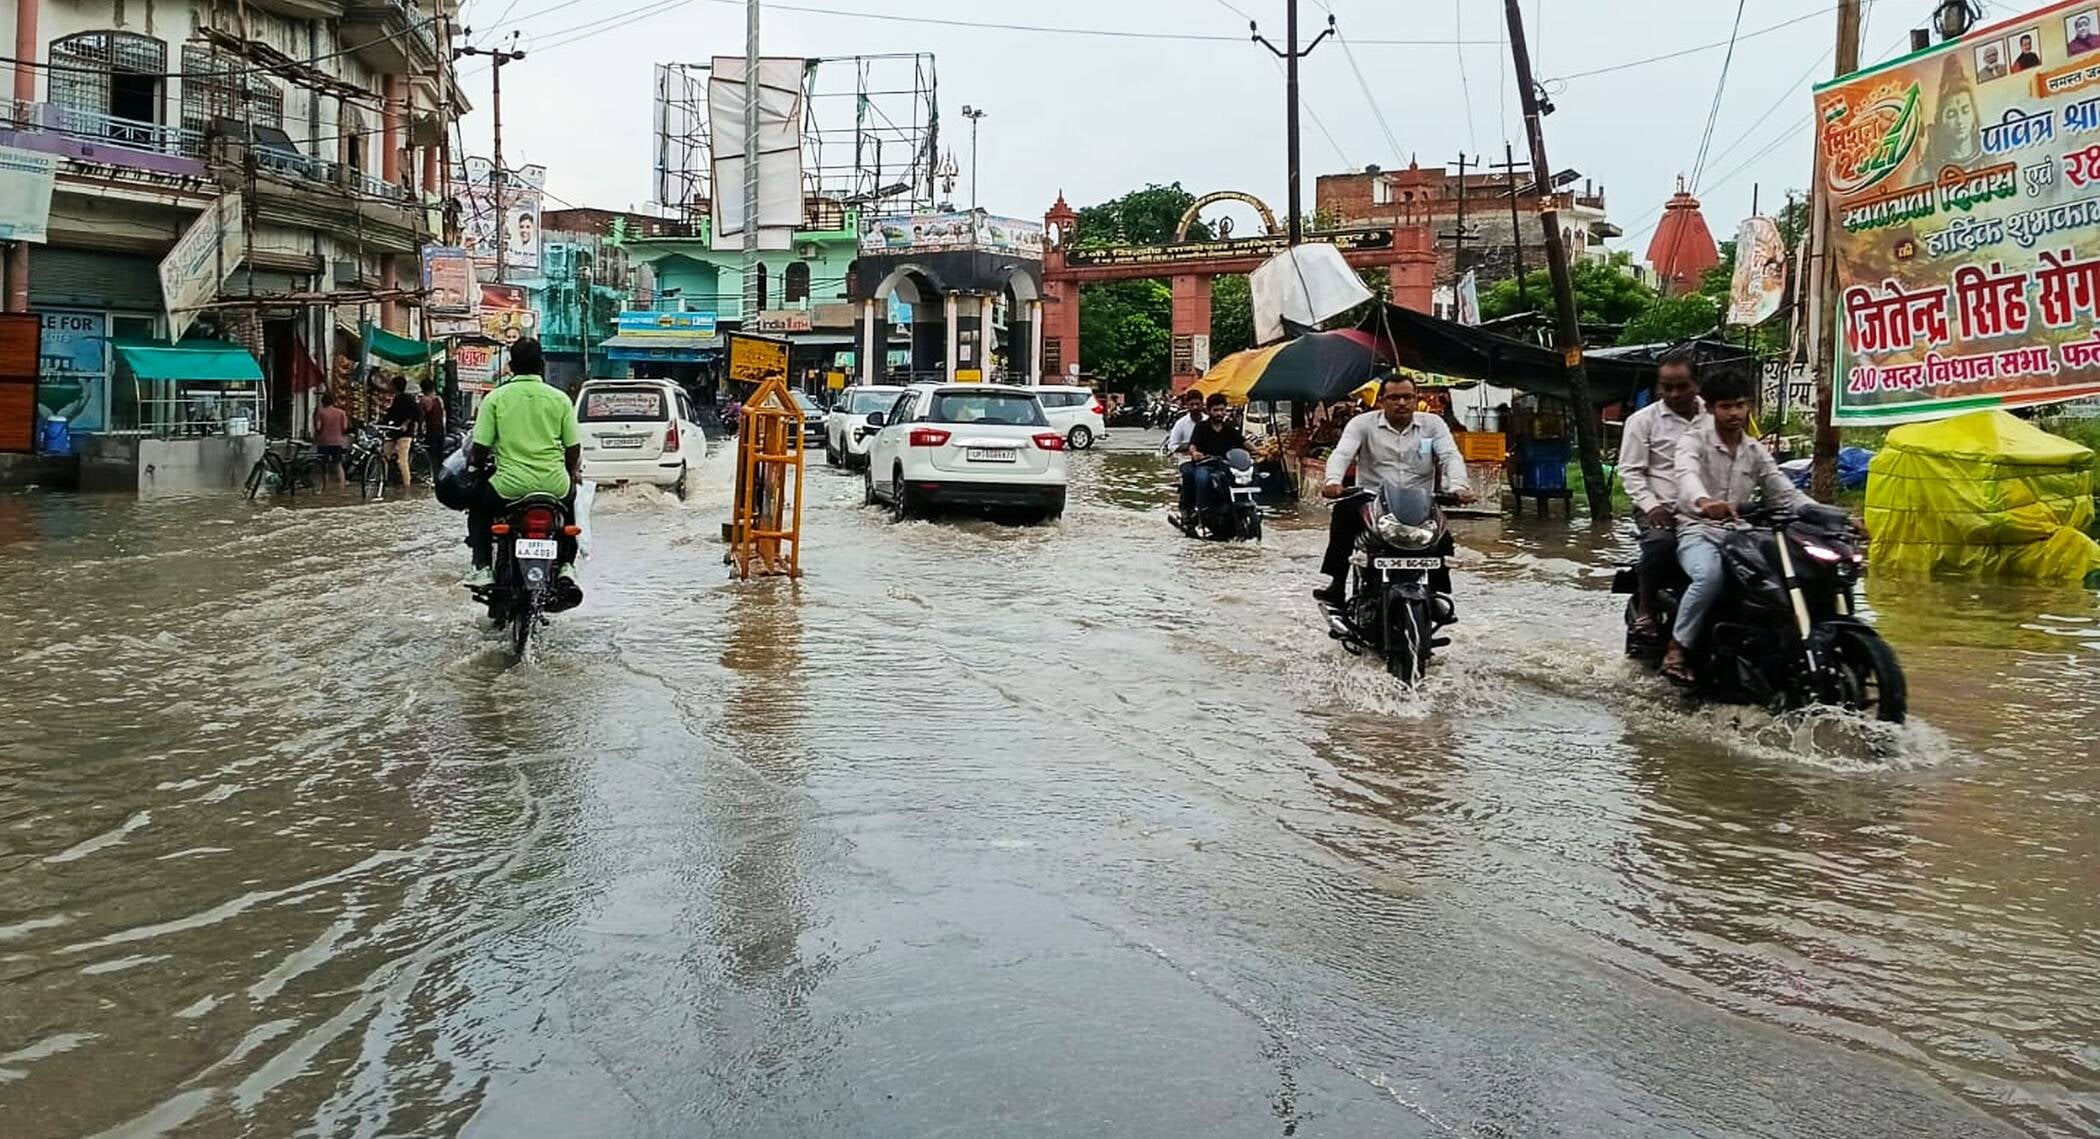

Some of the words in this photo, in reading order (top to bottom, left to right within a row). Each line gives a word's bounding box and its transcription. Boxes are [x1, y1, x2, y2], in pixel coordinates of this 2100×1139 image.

[1981, 108, 2054, 151] पवित्र
[1840, 183, 1935, 233] स्वतंत्रता
[1937, 162, 2017, 212] दिवस
[2024, 155, 2053, 197] एवं
[1925, 217, 2003, 257] हार्दिक
[61, 317, 92, 331] FOR
[1844, 279, 1948, 353] जितेन्द्र
[1955, 262, 2028, 338] सिंह
[1850, 367, 1877, 392] 240
[1882, 365, 1925, 389] सदर
[1927, 354, 1994, 384] विधान
[2000, 347, 2057, 374] सभा,
